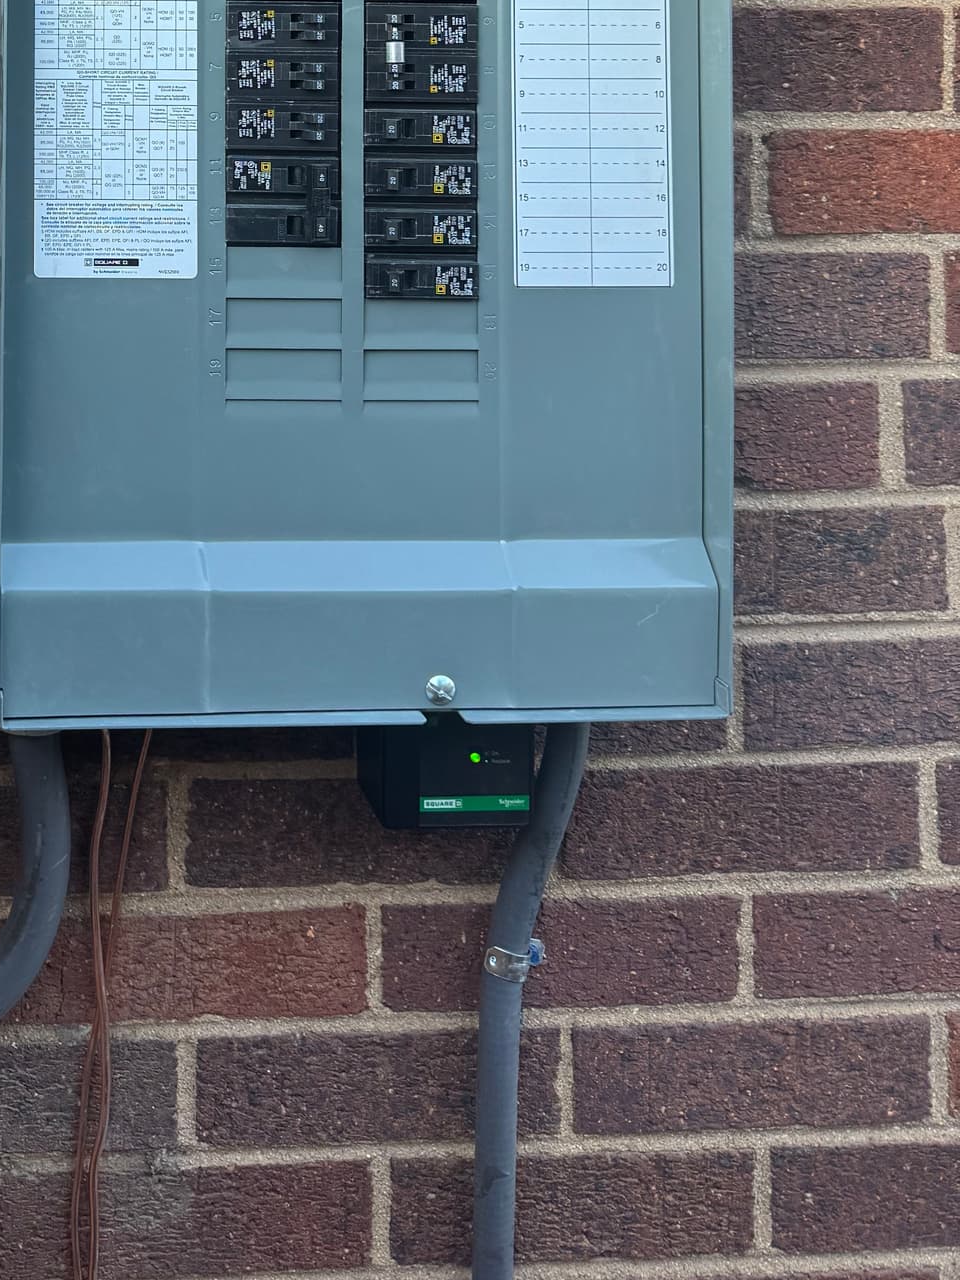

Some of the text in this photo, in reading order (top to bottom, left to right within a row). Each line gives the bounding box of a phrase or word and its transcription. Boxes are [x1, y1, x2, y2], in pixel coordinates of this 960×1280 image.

[316, 15, 323, 23] 20
[391, 14, 398, 23] 20
[518, 20, 525, 29] 5
[655, 21, 661, 30] 6
[316, 31, 323, 40] 20
[392, 30, 399, 40] 20
[519, 54, 525, 63] 7
[655, 55, 662, 64] 8
[209, 63, 223, 73] 7
[392, 64, 398, 73] 20
[316, 80, 323, 90] 20
[392, 81, 399, 90] 20
[519, 89, 526, 98] 9
[654, 90, 665, 99] 10
[210, 111, 223, 122] 9
[483, 114, 496, 130] 10
[389, 125, 395, 134] 20
[517, 124, 527, 132] 11
[655, 124, 665, 133] 12
[316, 132, 323, 141] 20
[209, 158, 223, 175] 11
[518, 159, 529, 168] 13
[655, 159, 666, 168] 14
[483, 164, 496, 180] 12
[319, 173, 325, 182] 40
[390, 176, 397, 184] 20
[519, 193, 530, 202] 15
[656, 193, 667, 202] 16
[318, 224, 324, 233] 40
[519, 228, 529, 237] 17
[656, 228, 667, 237] 18
[209, 257, 223, 276] 15
[519, 263, 530, 272] 19
[656, 262, 668, 272] 20
[483, 265, 497, 281] 16
[391, 278, 398, 287] 20
[209, 306, 222, 327] 17
[209, 359, 222, 377] 19
[425, 800, 453, 808] SQUARE
